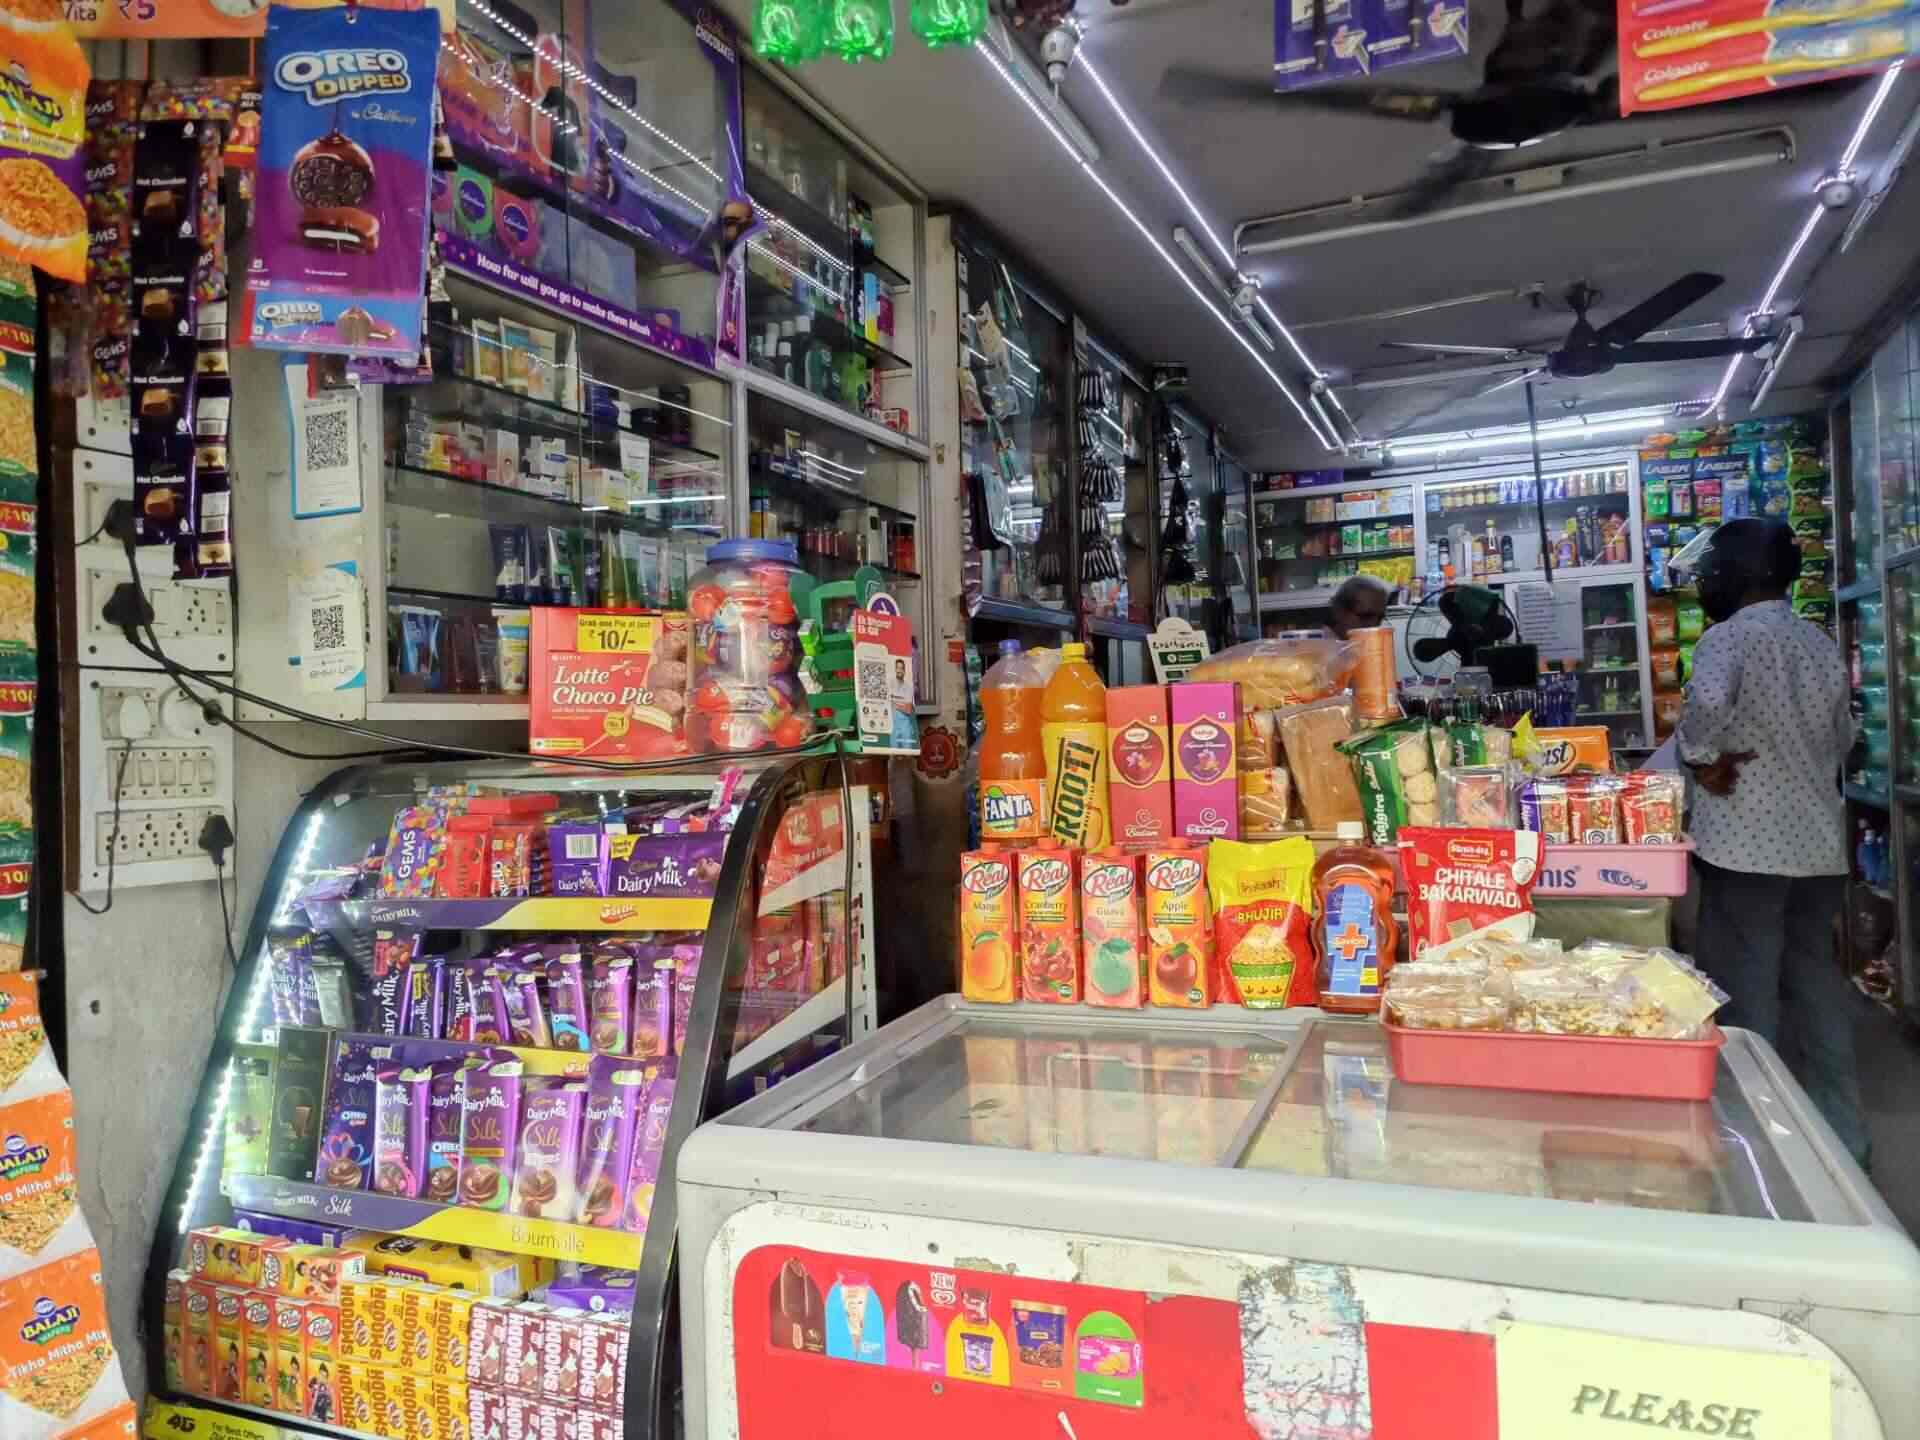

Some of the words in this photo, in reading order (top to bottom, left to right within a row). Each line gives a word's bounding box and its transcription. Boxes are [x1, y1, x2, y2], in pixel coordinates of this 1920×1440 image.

[1643, 20, 1709, 41] Colgate
[281, 52, 403, 84] OREO
[1643, 61, 1710, 81] Colgate
[314, 74, 405, 97] DIPPED
[477, 253, 501, 274] How
[502, 264, 521, 281] far
[520, 274, 539, 290] will
[540, 283, 558, 299] you
[559, 292, 571, 304] go
[572, 296, 581, 308] to
[583, 301, 606, 318] make
[608, 310, 630, 327] them
[552, 665, 610, 685] Lotte
[552, 686, 616, 705] Choco
[620, 687, 655, 705] Pie
[984, 795, 1033, 821] FANTA
[399, 830, 417, 880] GEMS
[617, 875, 653, 894] Dairy
[970, 863, 1007, 891] Real
[1027, 862, 1065, 891] Real
[1091, 866, 1130, 895] Real
[1156, 861, 1196, 890] Real
[1435, 867, 1505, 890] CHITALE
[1161, 900, 1188, 913] Apple
[1419, 883, 1522, 909] BAKARWADI
[464, 1099, 485, 1113] Dairy
[527, 1108, 550, 1121] Dairy
[325, 1194, 353, 1217] Silk
[23, 1306, 79, 1339] BALAJI
[342, 1285, 354, 1355] SMOODH
[370, 1287, 386, 1361] SMOODH
[401, 1293, 419, 1368] SMOODH
[434, 1300, 453, 1375] SMOODH
[468, 1306, 488, 1379] SMOODH
[504, 1312, 524, 1385] SMOODH
[543, 1319, 561, 1391] SMOODH
[579, 1323, 599, 1398] SMOODH
[1571, 1384, 1763, 1440] PLEASE
